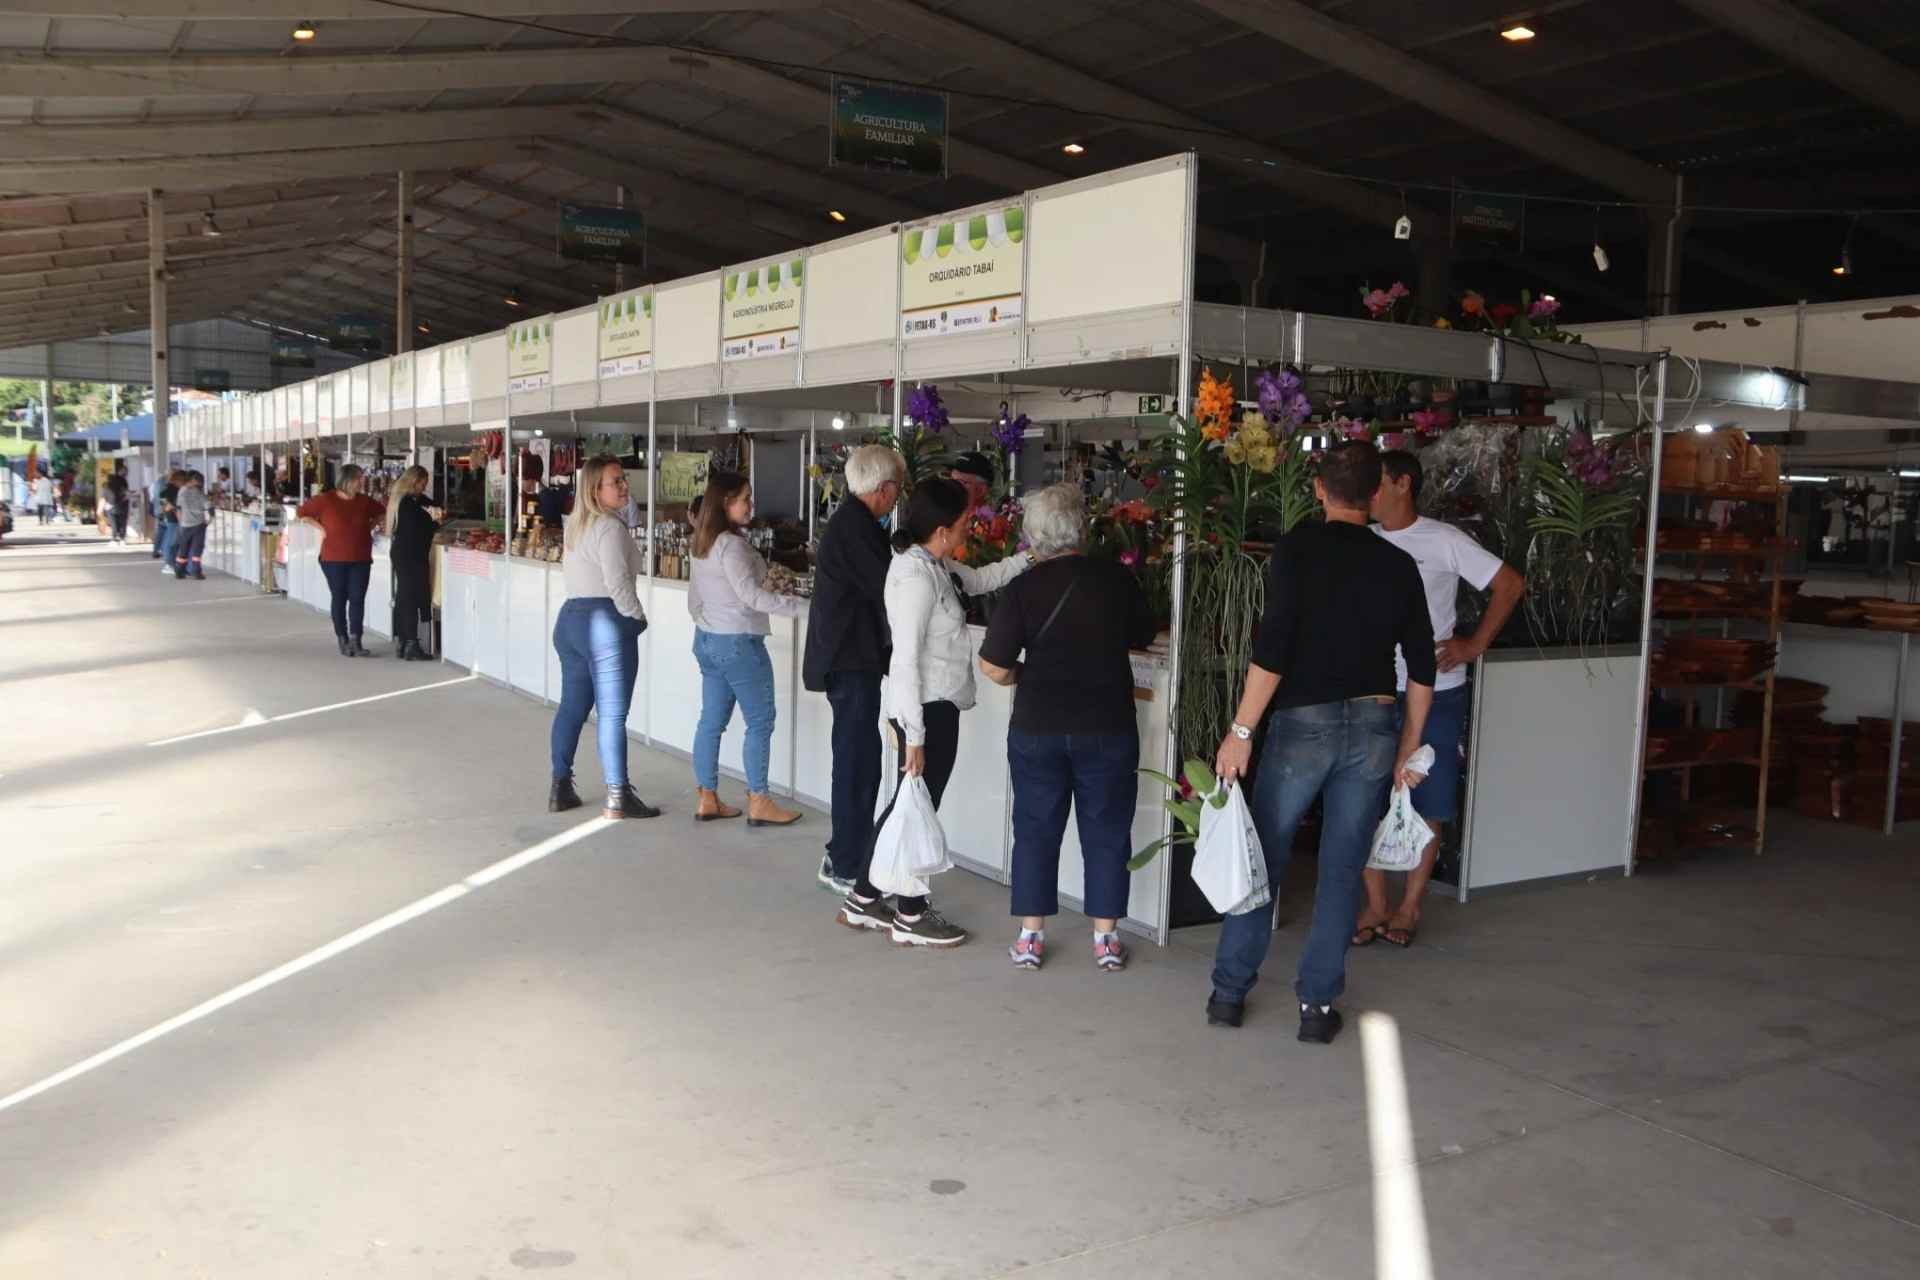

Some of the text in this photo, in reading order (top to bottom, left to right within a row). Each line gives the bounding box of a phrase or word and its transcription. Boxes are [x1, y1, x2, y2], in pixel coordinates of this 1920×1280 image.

[853, 113, 928, 133] AGRICULTURA
[865, 129, 915, 146] FAMILIAR
[973, 258, 994, 275] TABAÍ
